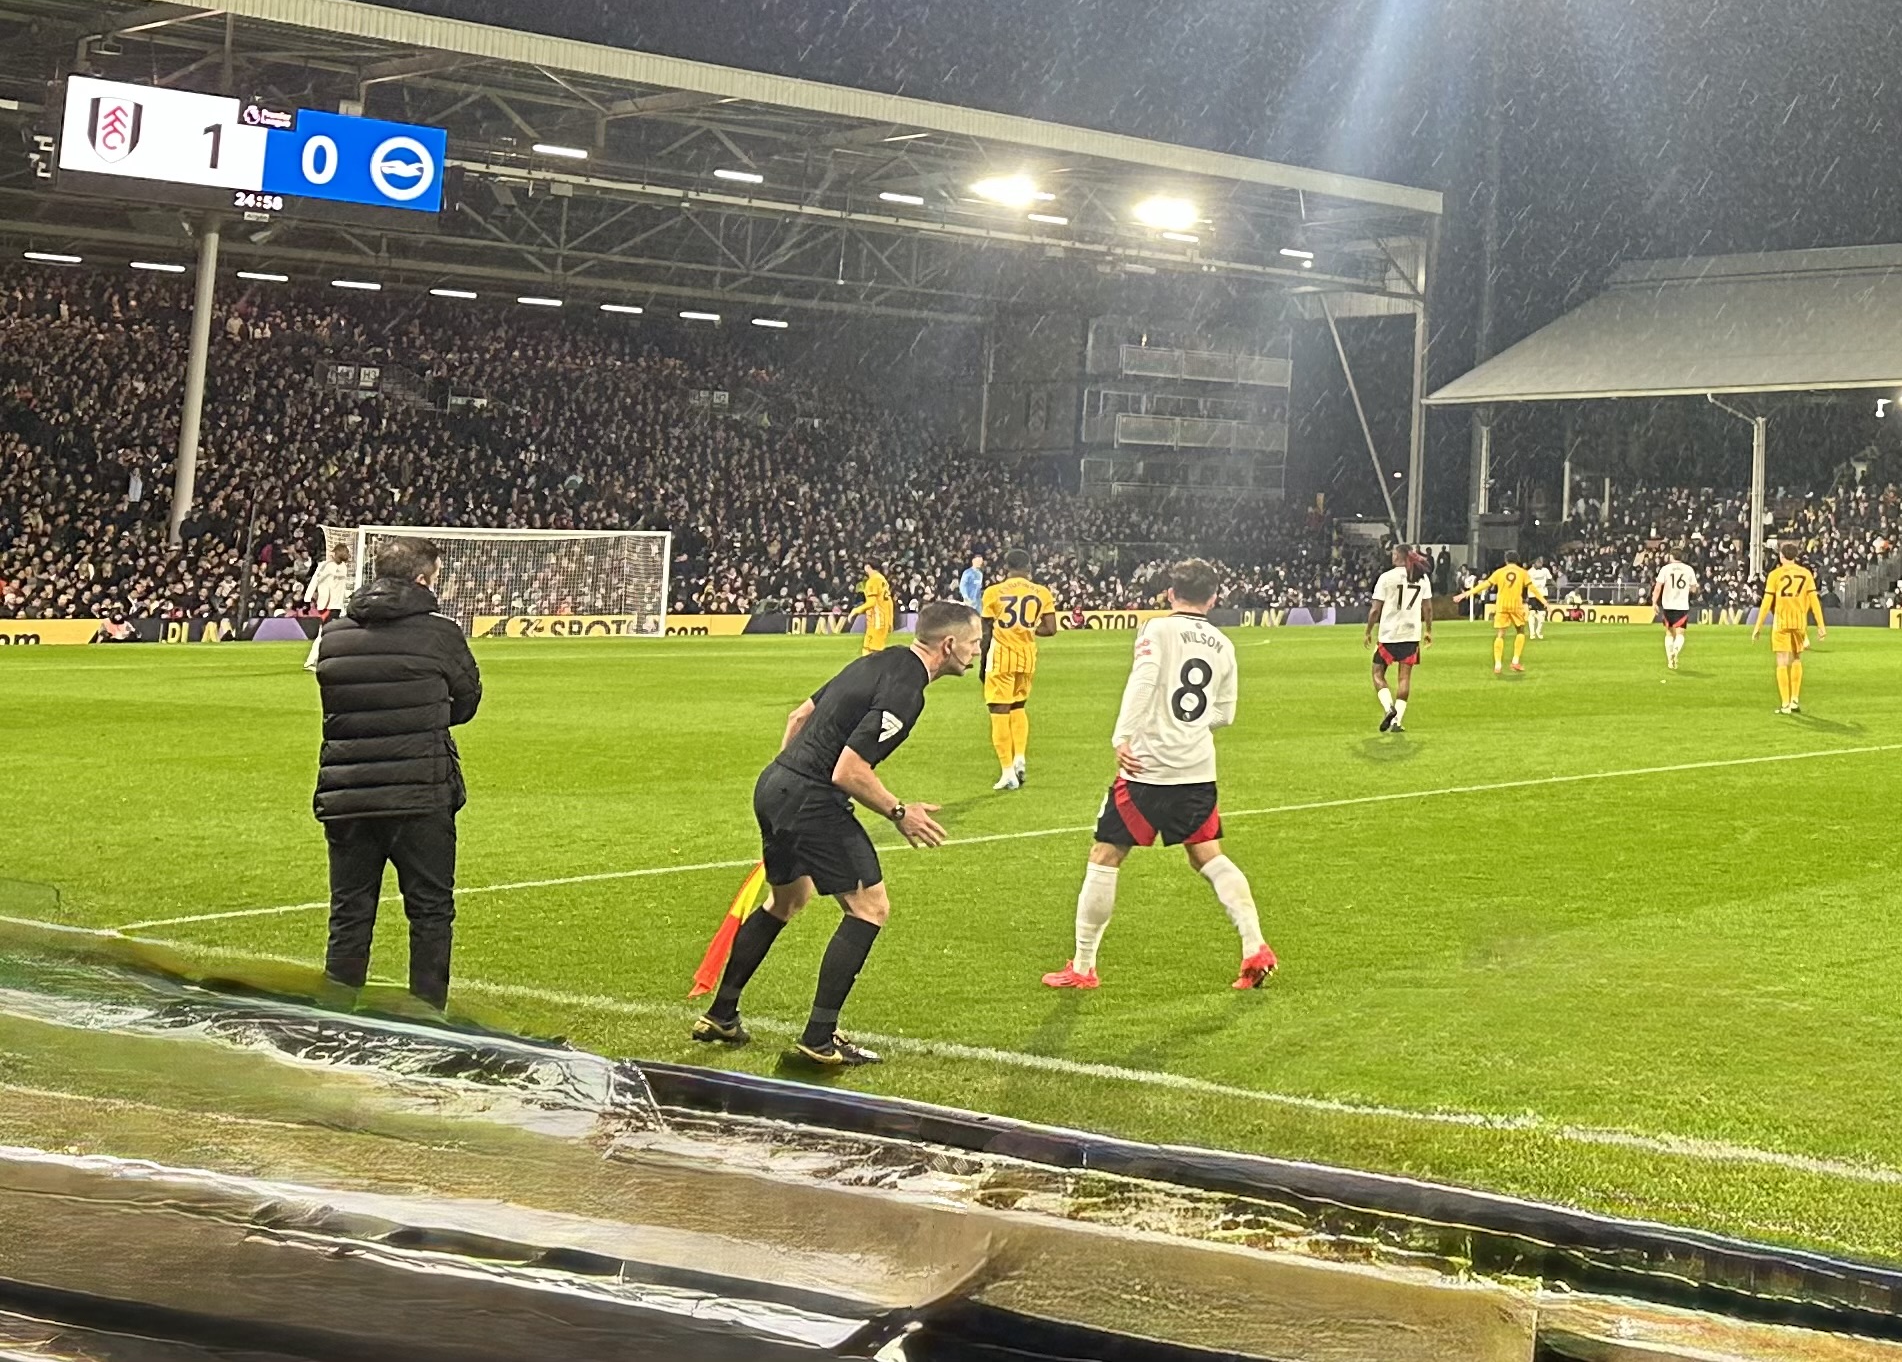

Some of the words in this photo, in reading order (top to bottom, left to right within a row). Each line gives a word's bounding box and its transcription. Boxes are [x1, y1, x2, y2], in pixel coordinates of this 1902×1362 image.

[203, 123, 222, 169] 1
[302, 135, 338, 185] 0
[234, 191, 283, 211] 24:58
[1506, 572, 1516, 588] 9
[1670, 573, 1686, 589] 16
[1780, 575, 1807, 597] 27
[1396, 584, 1421, 610] 17
[998, 595, 1042, 628] 30
[1180, 631, 1223, 654] WILSON
[1172, 658, 1212, 723] 8
